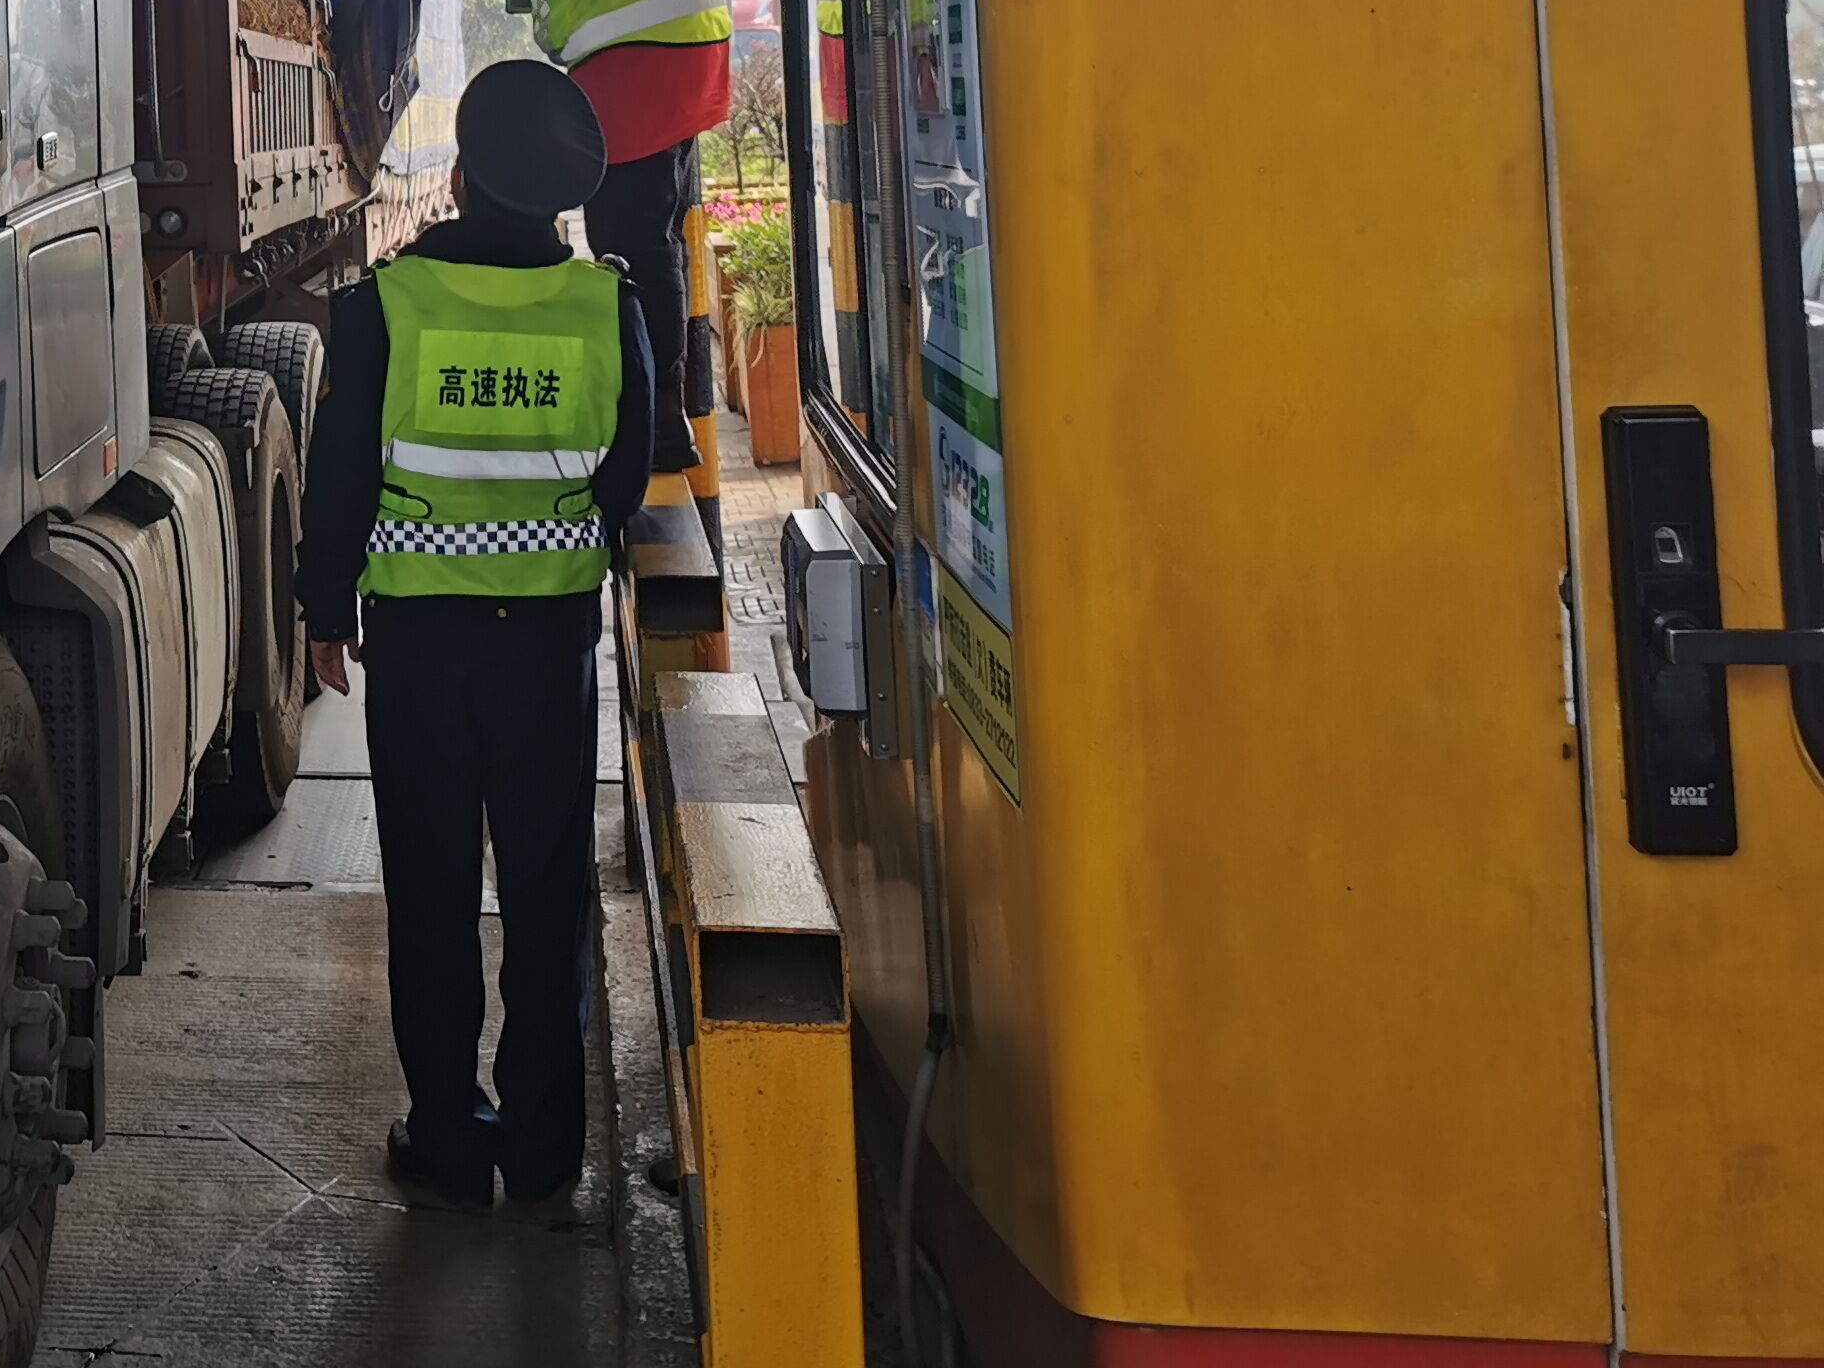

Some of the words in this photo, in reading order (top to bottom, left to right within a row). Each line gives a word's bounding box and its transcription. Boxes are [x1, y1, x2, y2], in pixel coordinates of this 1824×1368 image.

[438, 365, 561, 408] 高速执法
[1669, 786, 1707, 797] UIOT
